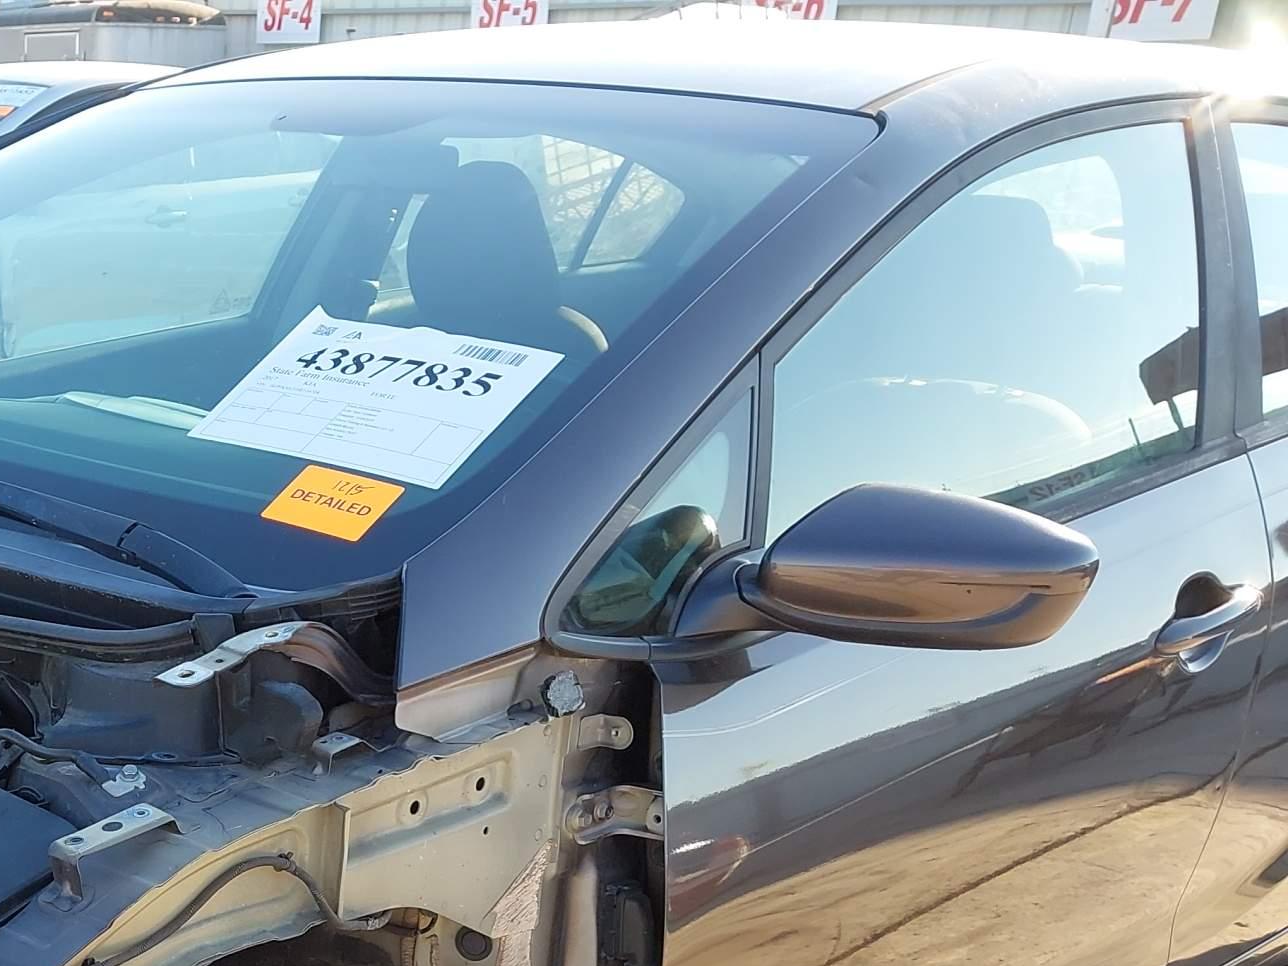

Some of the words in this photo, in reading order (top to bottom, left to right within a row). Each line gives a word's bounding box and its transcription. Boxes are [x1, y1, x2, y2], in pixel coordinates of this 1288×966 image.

[264, 0, 313, 32] SF-4
[272, 366, 295, 376] State
[295, 369, 321, 380] Farm
[322, 374, 370, 388] Insurance
[297, 347, 503, 397] 43877835
[290, 488, 372, 516] DETAILED
